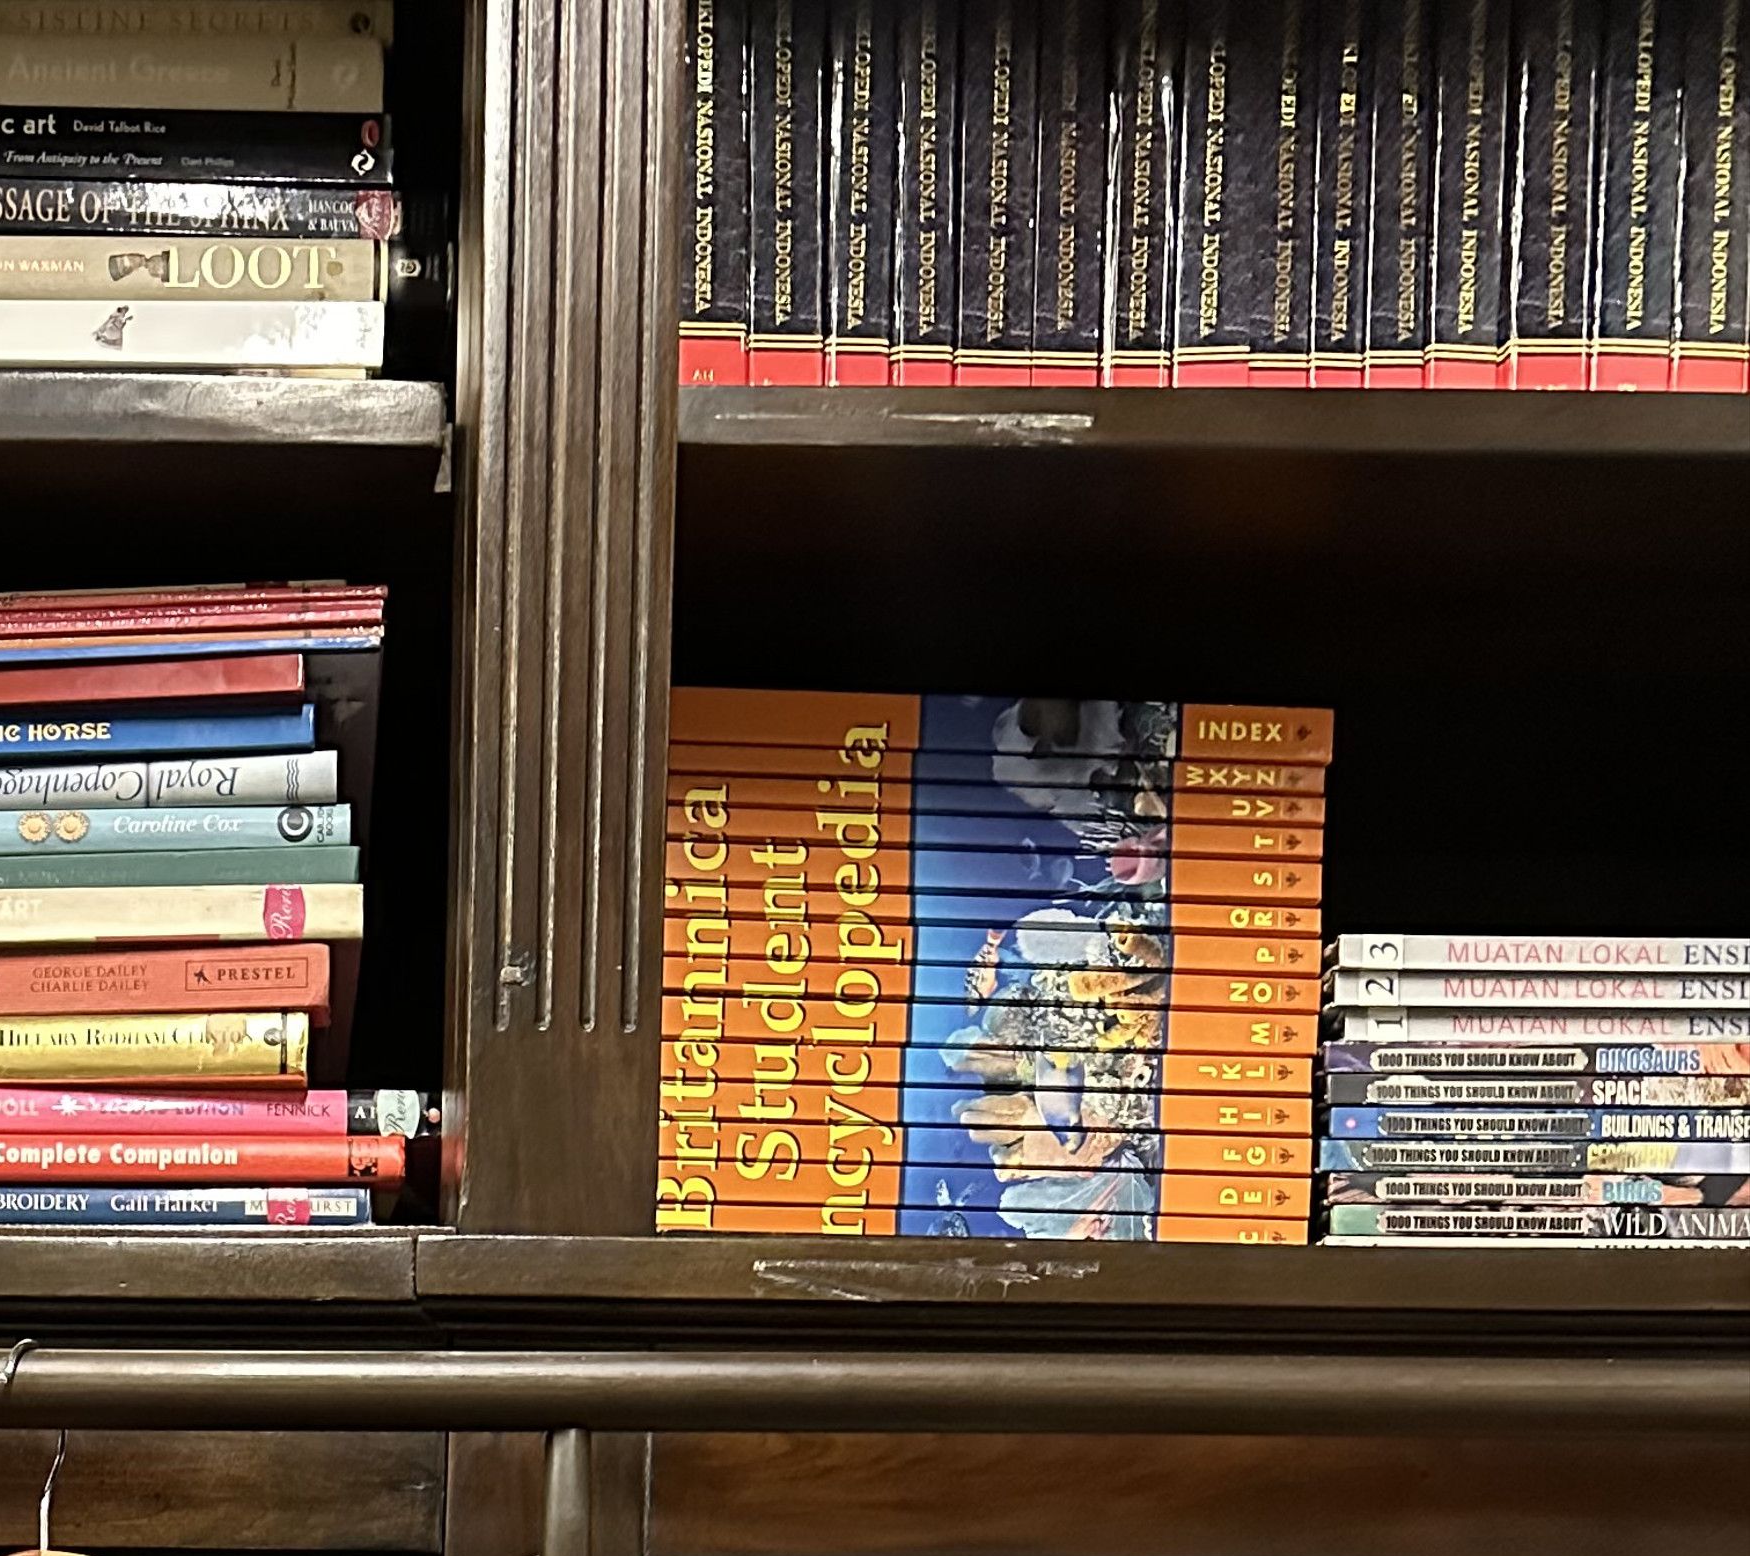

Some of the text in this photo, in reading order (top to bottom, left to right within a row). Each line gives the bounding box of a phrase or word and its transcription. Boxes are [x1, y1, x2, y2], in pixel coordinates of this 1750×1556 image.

[22, 116, 57, 135] art
[695, 101, 714, 314] NASIONAL INDONESIA
[166, 246, 337, 289] LOOT
[27, 720, 111, 742] HORSE
[1198, 721, 1282, 742] INDEX
[156, 761, 240, 800] Royal
[1448, 942, 1669, 964] MUATAN LOKAL
[216, 966, 296, 983] PRESTEL
[656, 784, 730, 1232] Britannica
[736, 839, 809, 1182] Student
[110, 1143, 238, 1167] Companion
